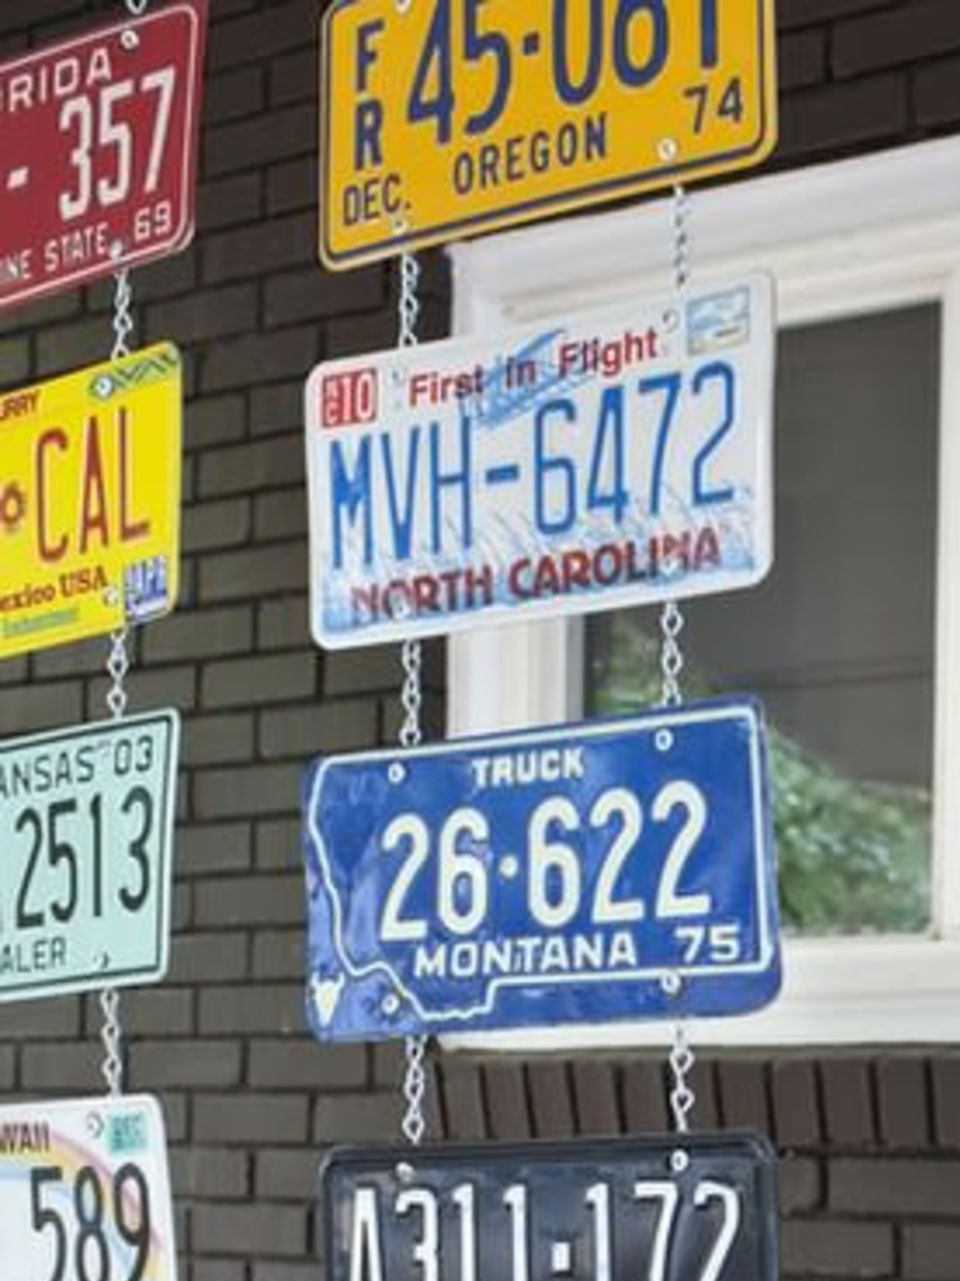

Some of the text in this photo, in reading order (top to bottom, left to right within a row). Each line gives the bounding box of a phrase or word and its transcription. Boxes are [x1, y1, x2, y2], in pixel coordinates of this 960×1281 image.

[0, 47, 112, 112] RIDA
[683, 77, 743, 134] 74
[453, 112, 607, 195] OREGON
[343, 174, 411, 227] DEC.
[44, 222, 109, 274] STATE
[134, 201, 171, 242] 69
[343, 374, 373, 421] 10
[410, 369, 486, 407] First
[559, 329, 659, 377] Flight
[36, 405, 149, 562] CAL
[331, 360, 735, 569] MVH-6472
[59, 565, 108, 598] USA
[352, 526, 723, 624] NORTH CAROLINA
[114, 735, 154, 775] 03
[472, 748, 585, 787] TRUCK
[15, 785, 153, 929] 2513
[0, 936, 66, 975] ALER
[414, 925, 740, 978] MONTANA 75
